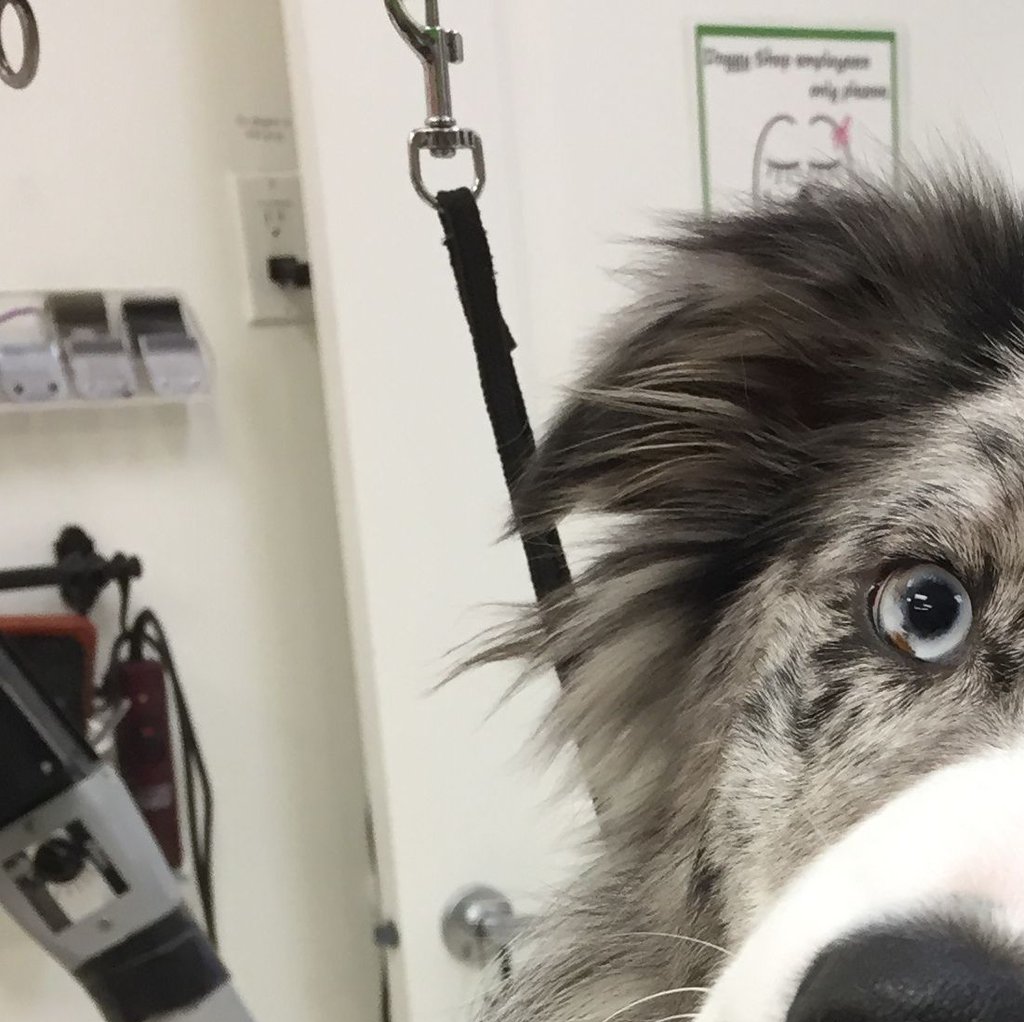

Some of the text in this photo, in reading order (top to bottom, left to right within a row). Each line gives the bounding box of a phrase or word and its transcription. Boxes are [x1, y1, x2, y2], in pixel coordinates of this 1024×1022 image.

[702, 48, 749, 73] Doggy
[796, 49, 870, 73] employees
[809, 81, 837, 103] only
